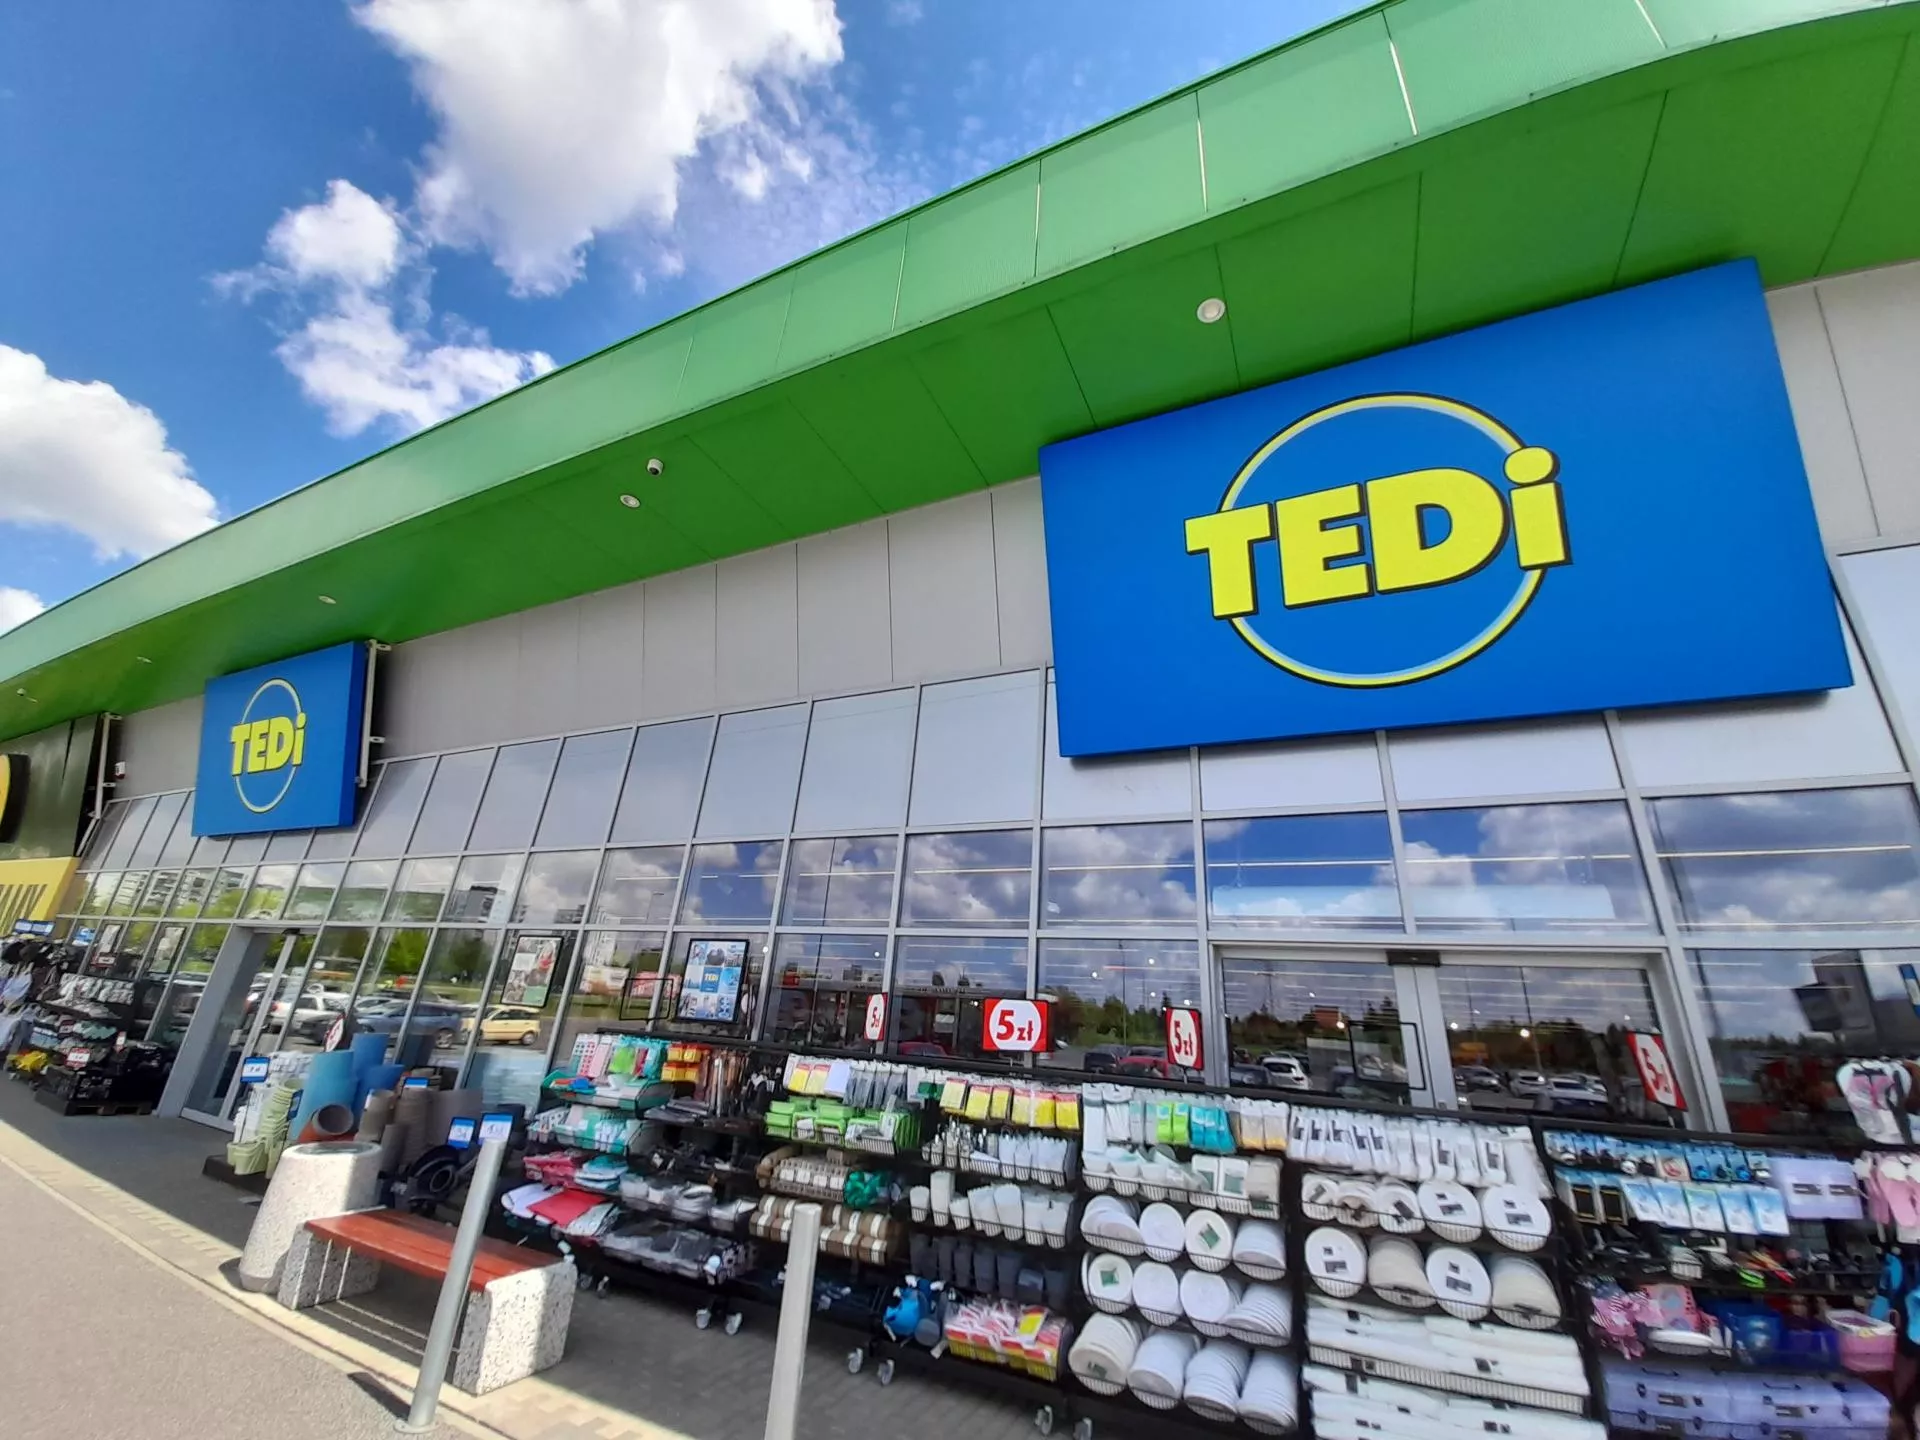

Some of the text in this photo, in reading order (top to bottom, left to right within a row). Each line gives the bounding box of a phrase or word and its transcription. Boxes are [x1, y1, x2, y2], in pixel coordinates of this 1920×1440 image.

[1184, 446, 1573, 619] TEDi
[230, 712, 307, 776] TEDi
[996, 1009, 1034, 1042] 5 zł
[1174, 1020, 1193, 1056] 5 zł
